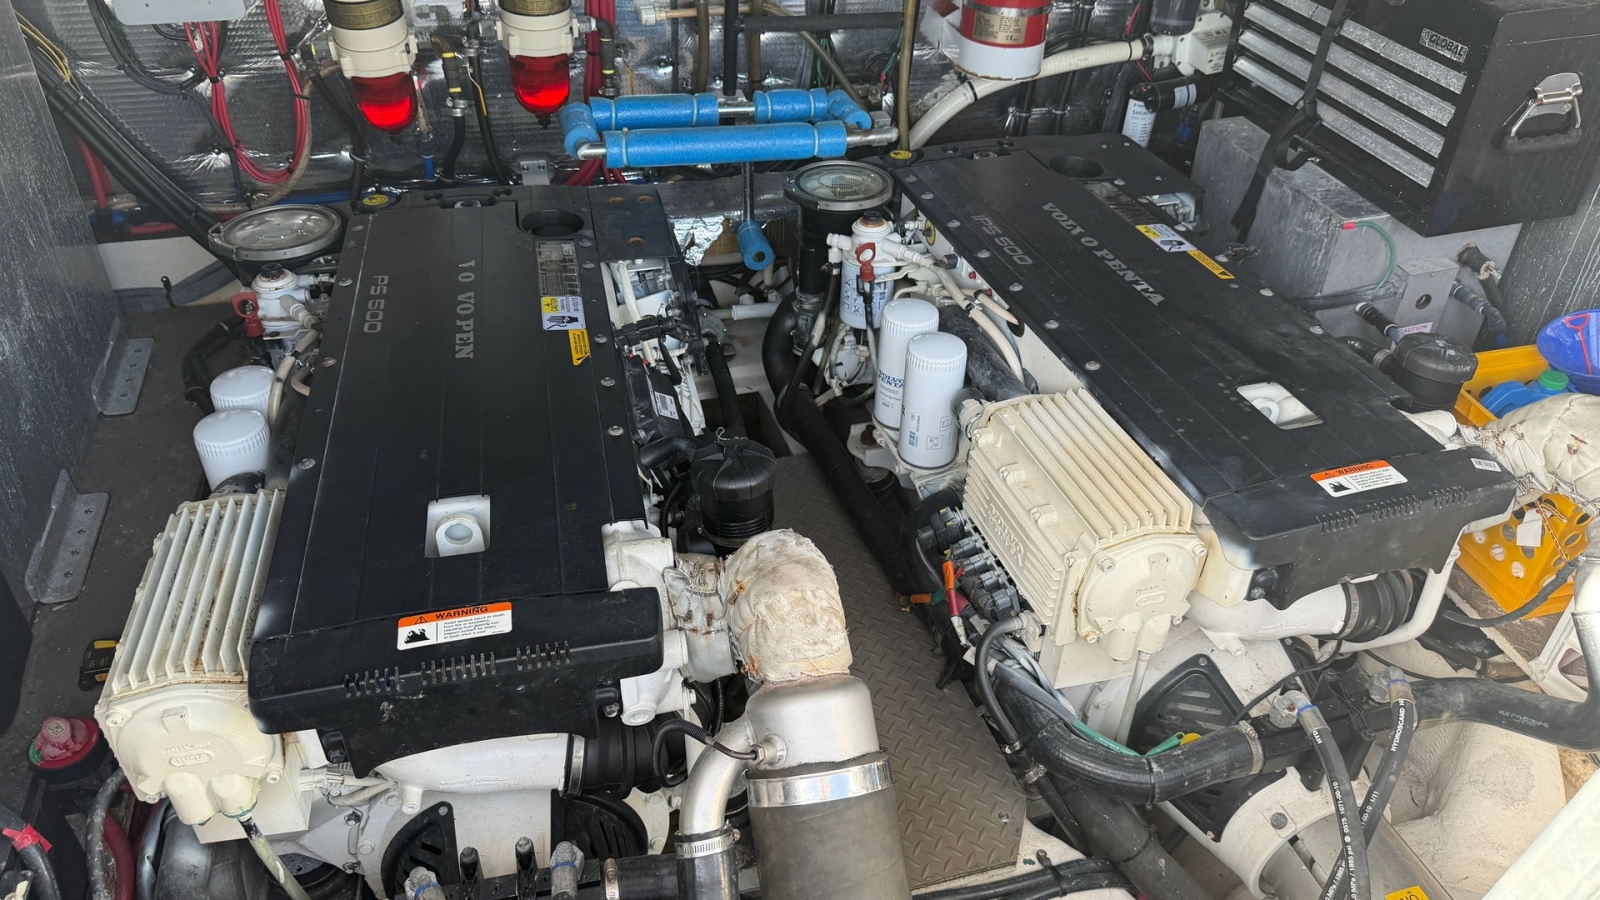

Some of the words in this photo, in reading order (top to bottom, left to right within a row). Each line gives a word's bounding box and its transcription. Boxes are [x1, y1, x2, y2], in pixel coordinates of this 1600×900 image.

[1430, 34, 1464, 57] GLOBAL
[994, 236, 1034, 265] 500
[1092, 248, 1166, 306] PENTA
[363, 299, 386, 333] 500
[1336, 463, 1374, 475] WARNING
[435, 606, 488, 619] WARNING
[1391, 707, 1406, 752] HYDROSCAND
[1332, 781, 1345, 815] 1071-00-10
[1341, 817, 1350, 833] 0575
[1327, 883, 1338, 896] MPa
